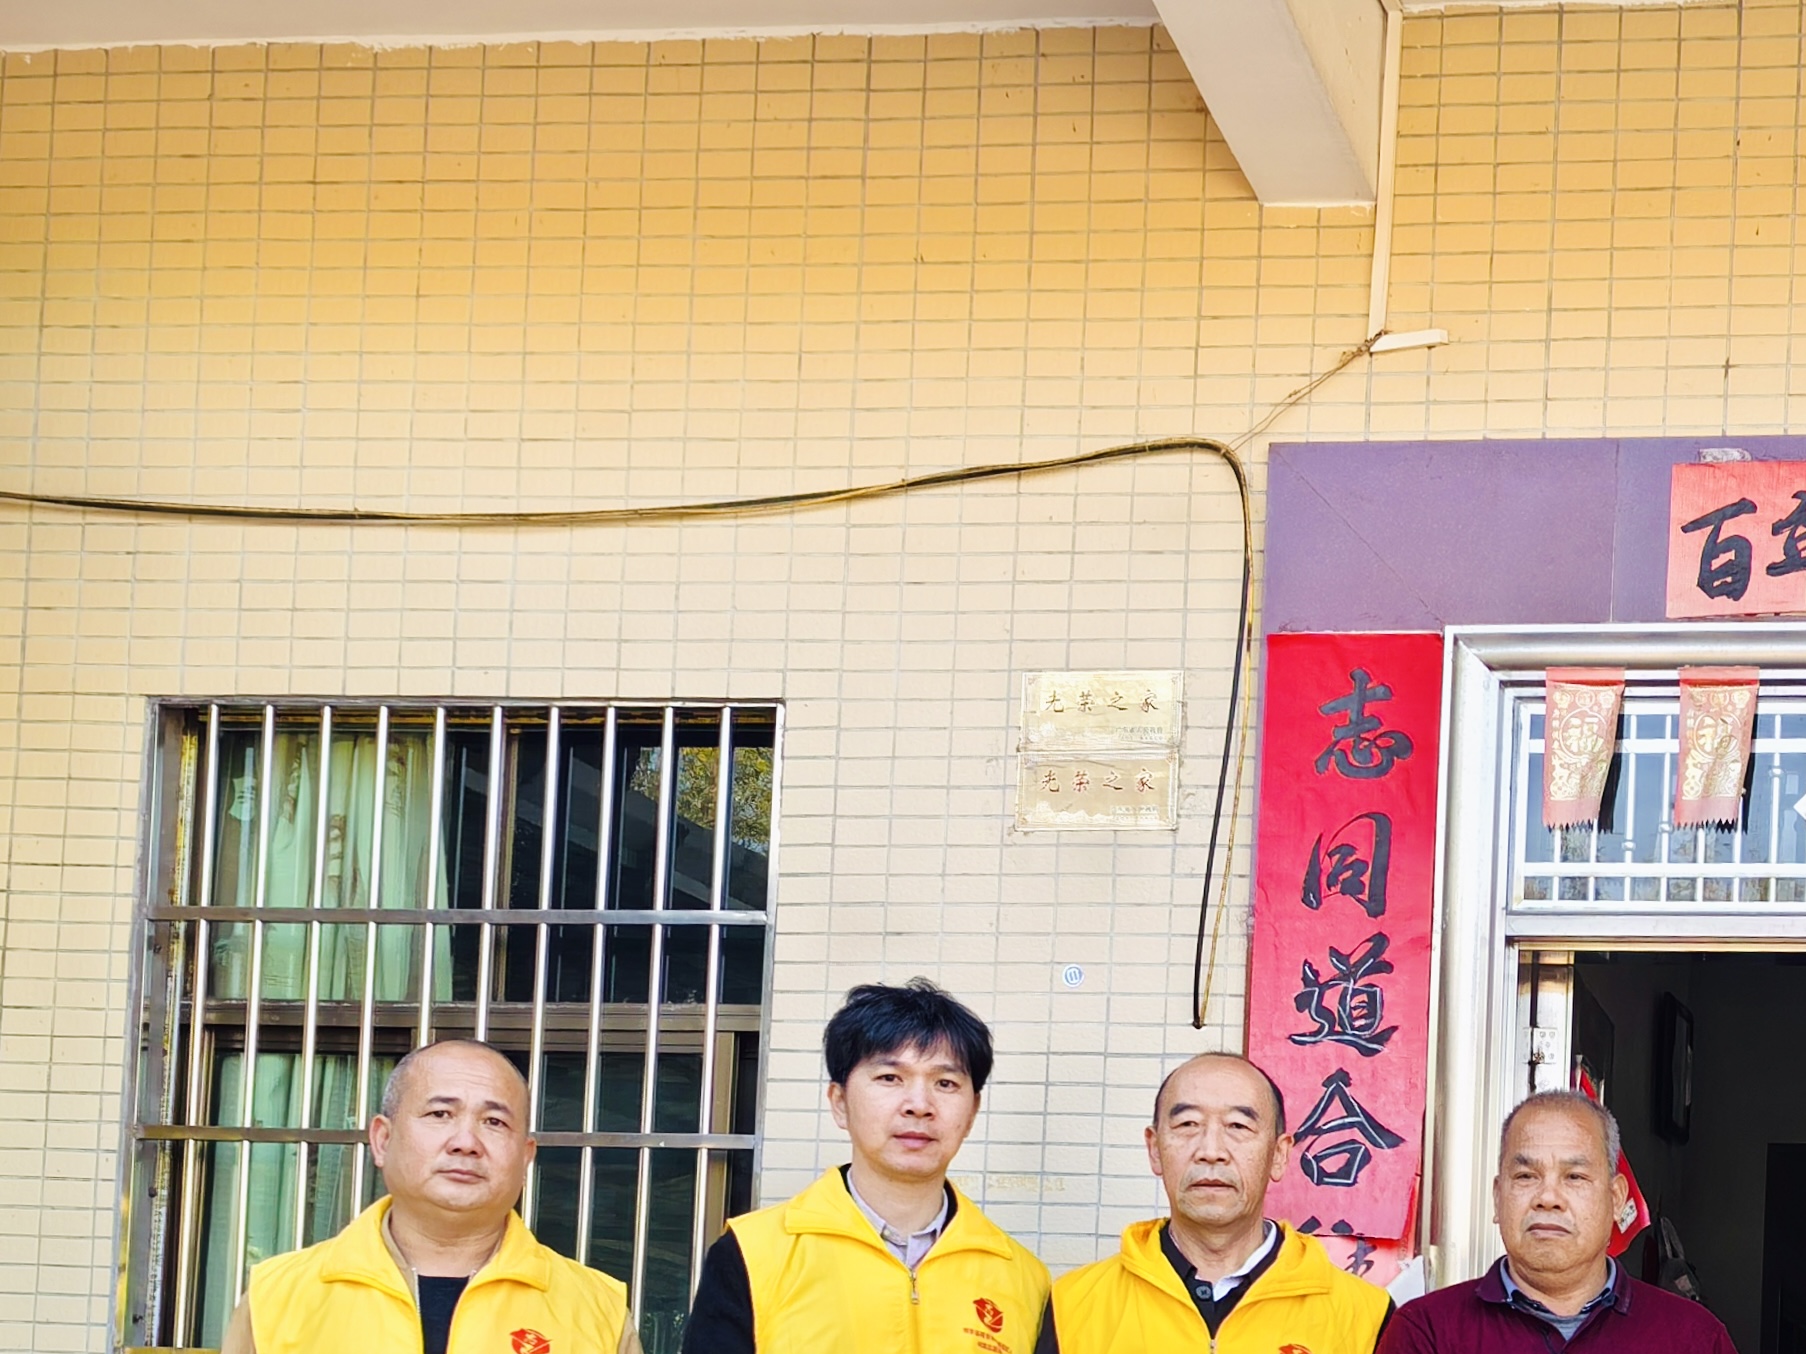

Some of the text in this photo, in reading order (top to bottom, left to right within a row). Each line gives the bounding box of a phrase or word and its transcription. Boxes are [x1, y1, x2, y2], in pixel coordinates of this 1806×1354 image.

[1045, 689, 1160, 713] 光荣之家
[1040, 768, 1155, 793] 光荣之家
[1286, 667, 1413, 1236] 志同道合
